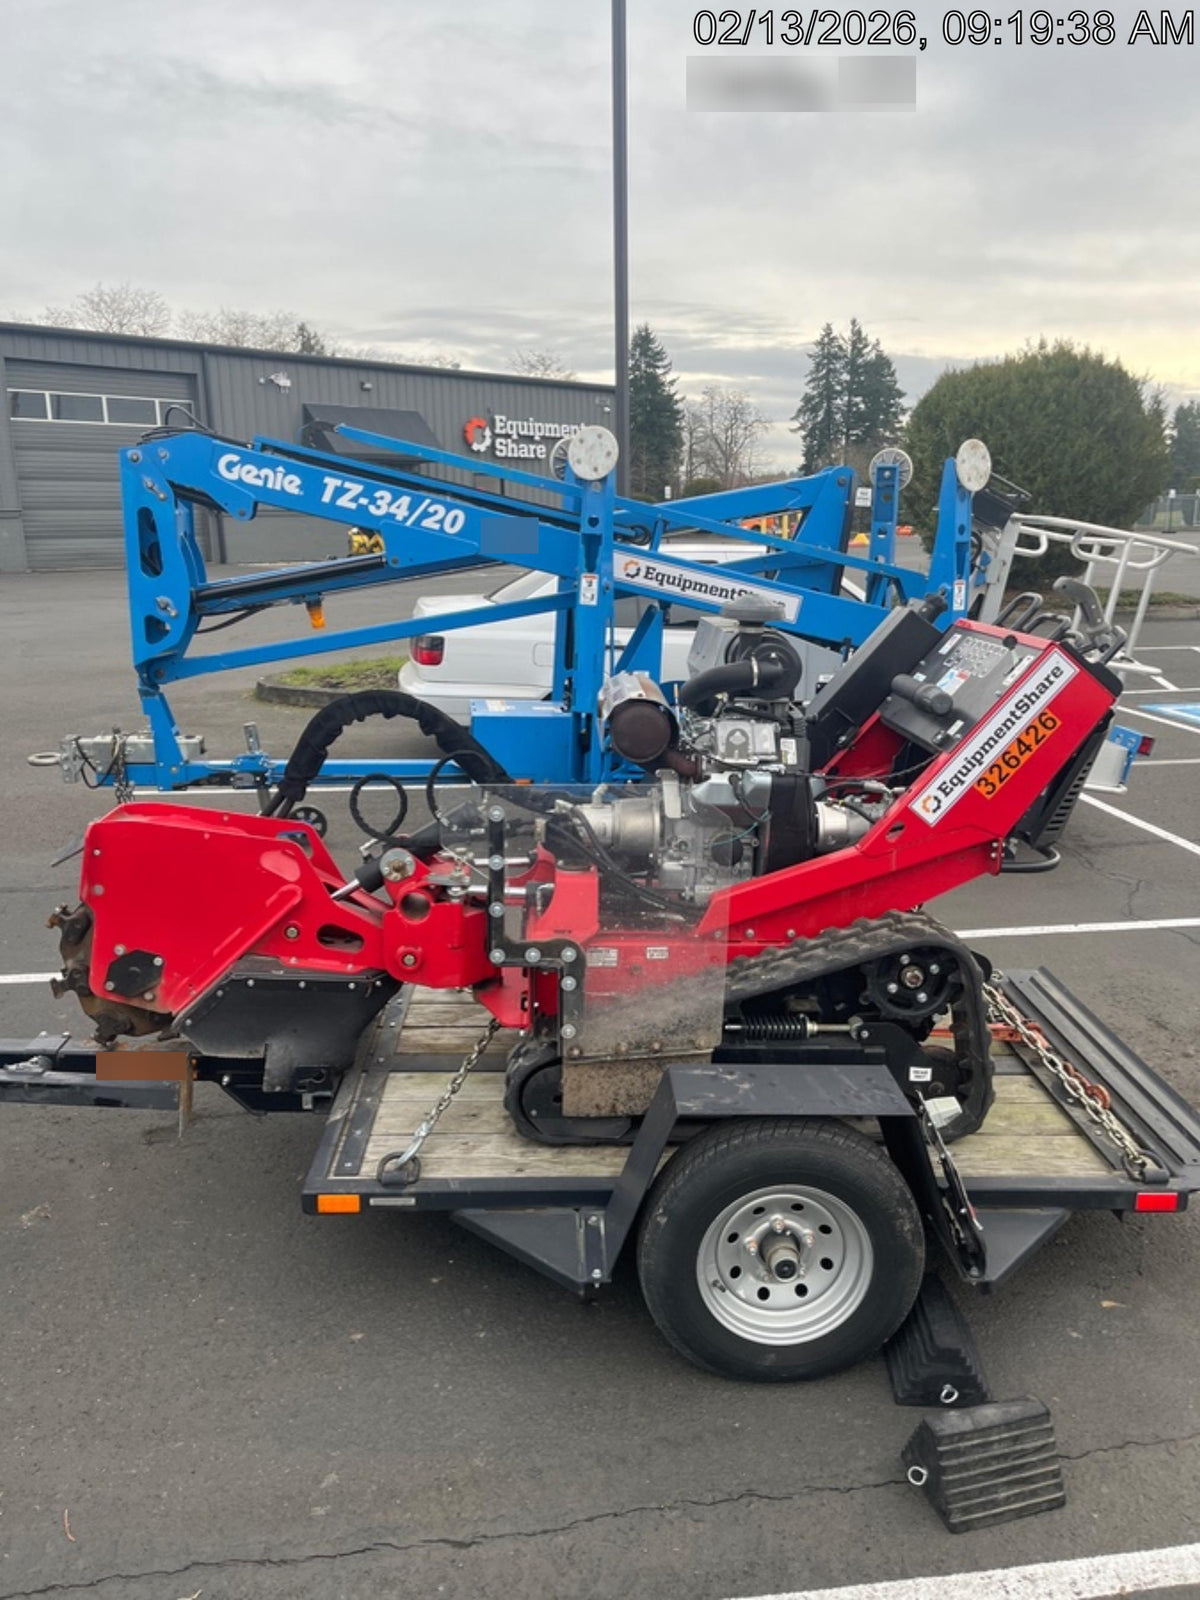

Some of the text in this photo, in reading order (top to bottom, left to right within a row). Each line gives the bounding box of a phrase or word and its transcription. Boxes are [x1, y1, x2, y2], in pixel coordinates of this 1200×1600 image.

[495, 438, 546, 458] Share
[217, 453, 466, 534] Genie TZ-34/20
[937, 665, 1064, 798] EquipmentShare
[977, 711, 1057, 796] 326426
